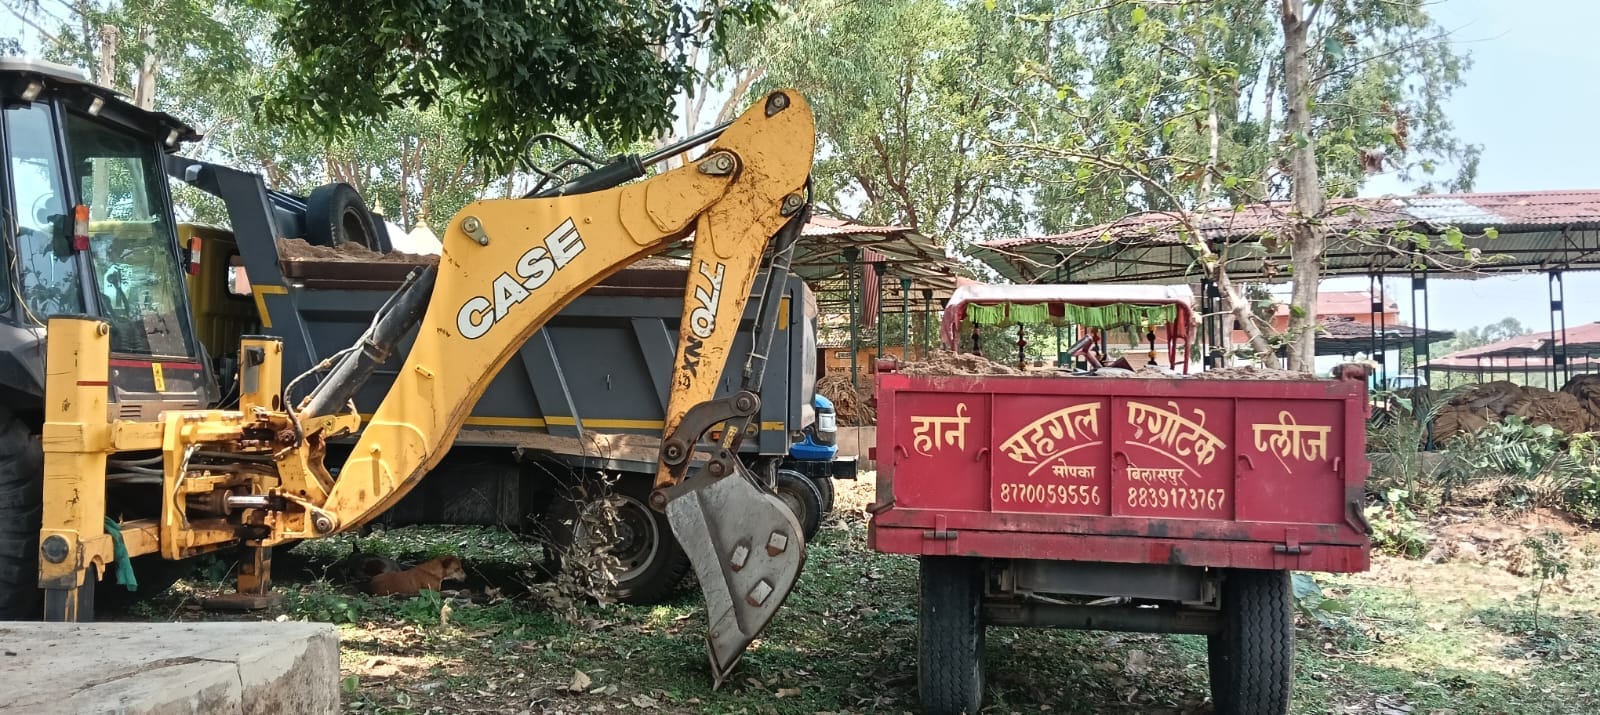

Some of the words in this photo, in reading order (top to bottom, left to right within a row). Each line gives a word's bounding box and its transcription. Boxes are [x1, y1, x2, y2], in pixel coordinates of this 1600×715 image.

[456, 216, 586, 339] CASE
[910, 402, 971, 457] हार्न
[999, 402, 1101, 465] सहगल
[1126, 400, 1227, 466] एग्रोटेक
[1252, 410, 1332, 474] प्लीज
[1000, 483, 1101, 505] 8770059556
[1127, 486, 1226, 510] 8839173767
[1126, 462, 1188, 486] बिलासपुर
